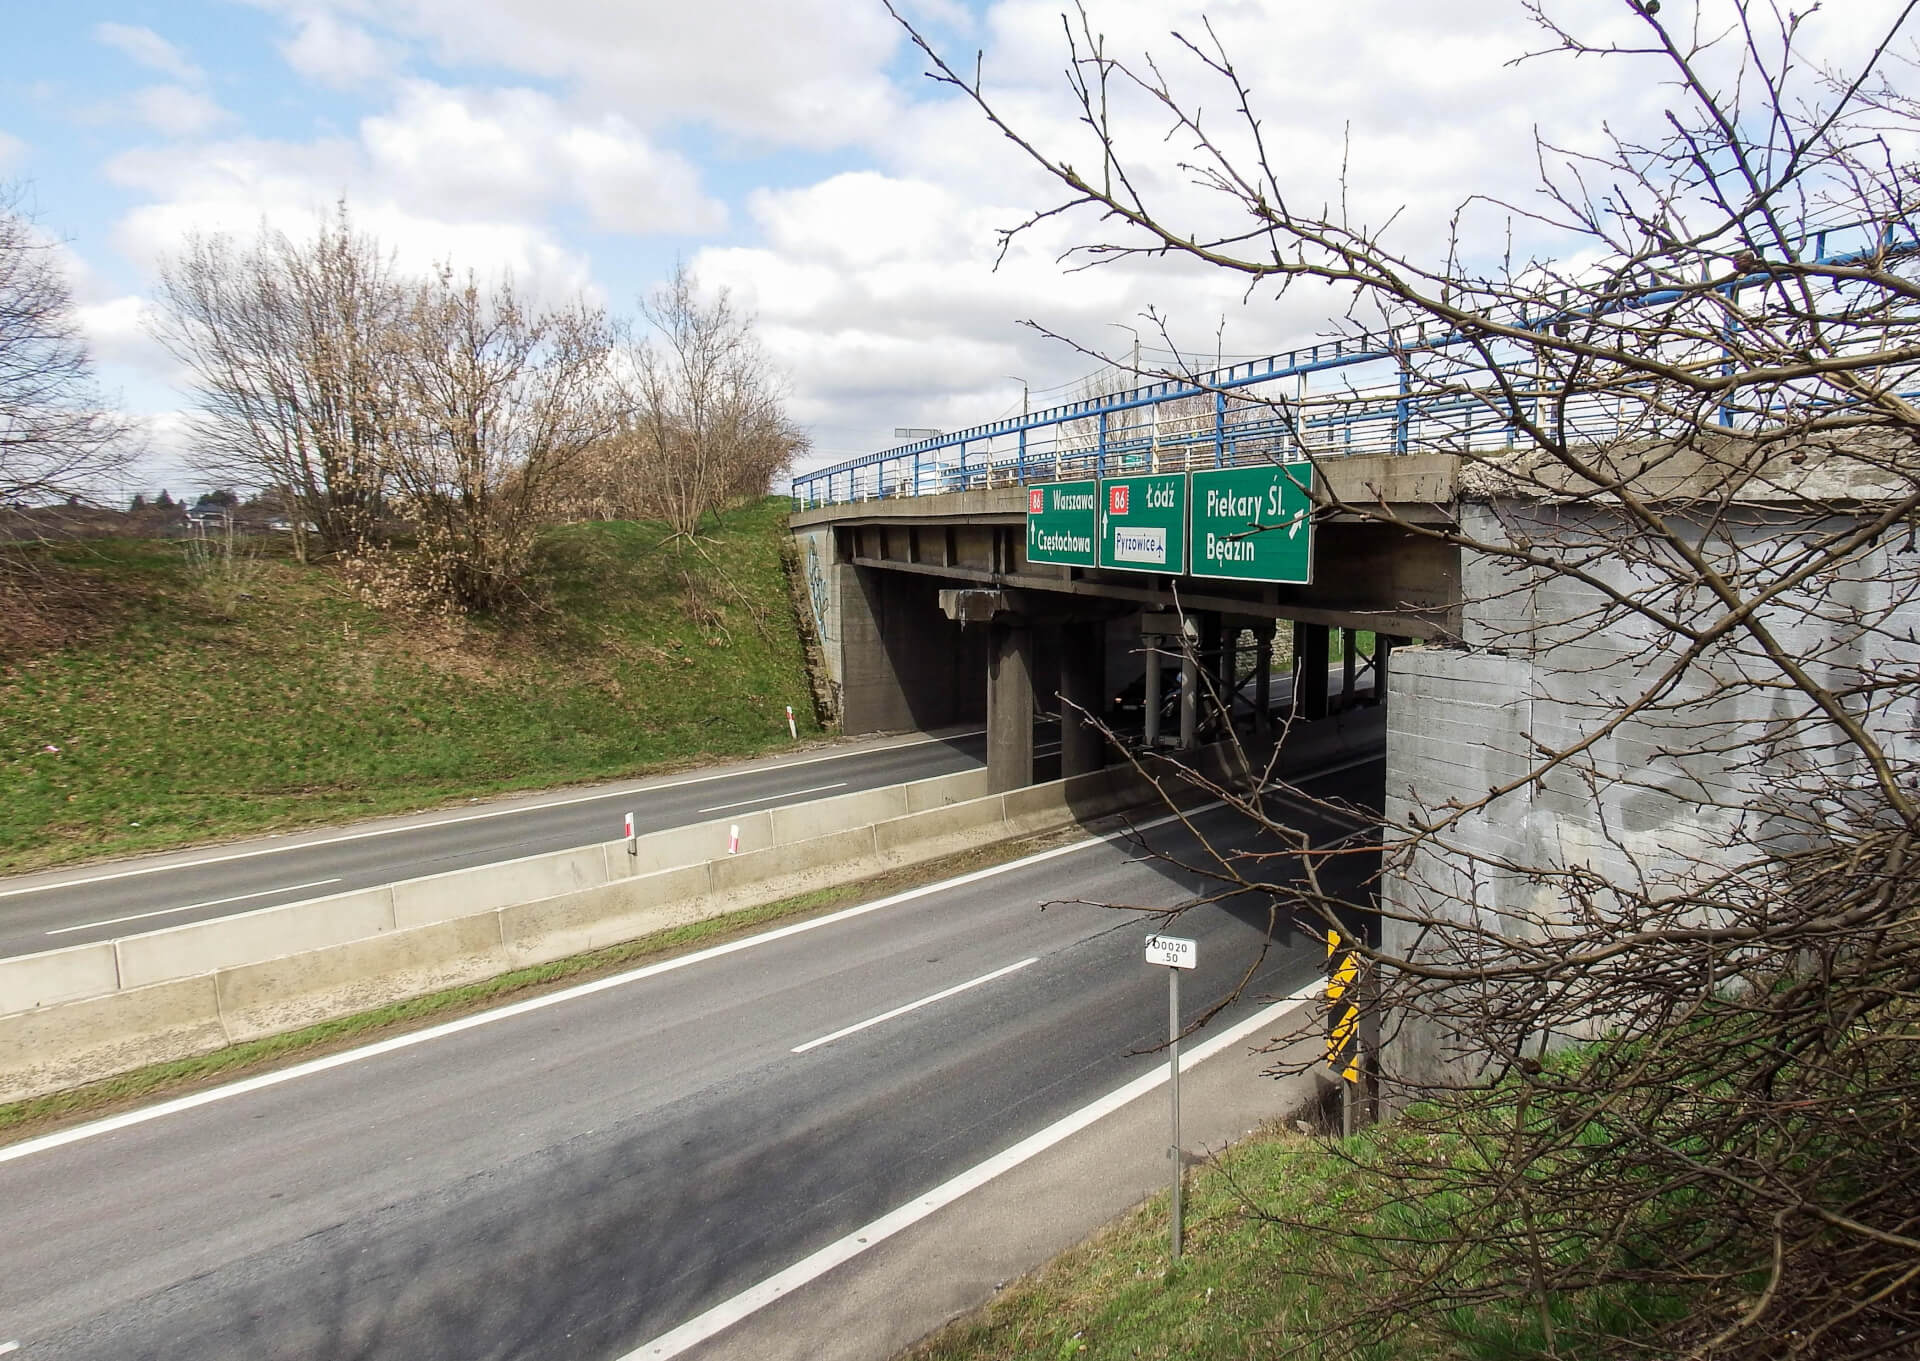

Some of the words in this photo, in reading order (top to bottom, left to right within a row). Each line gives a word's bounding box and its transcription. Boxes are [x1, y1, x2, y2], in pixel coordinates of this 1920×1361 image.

[1032, 494, 1041, 510] 86
[1053, 489, 1094, 510] Warszawa
[1114, 490, 1125, 510] 86
[1146, 481, 1175, 508] Łódź
[1207, 488, 1263, 526] Piekary
[1267, 474, 1286, 516] Śl.
[1037, 529, 1091, 556] Częstochowa
[1116, 532, 1156, 555] Pyrzowice
[1207, 532, 1255, 568] Będzin
